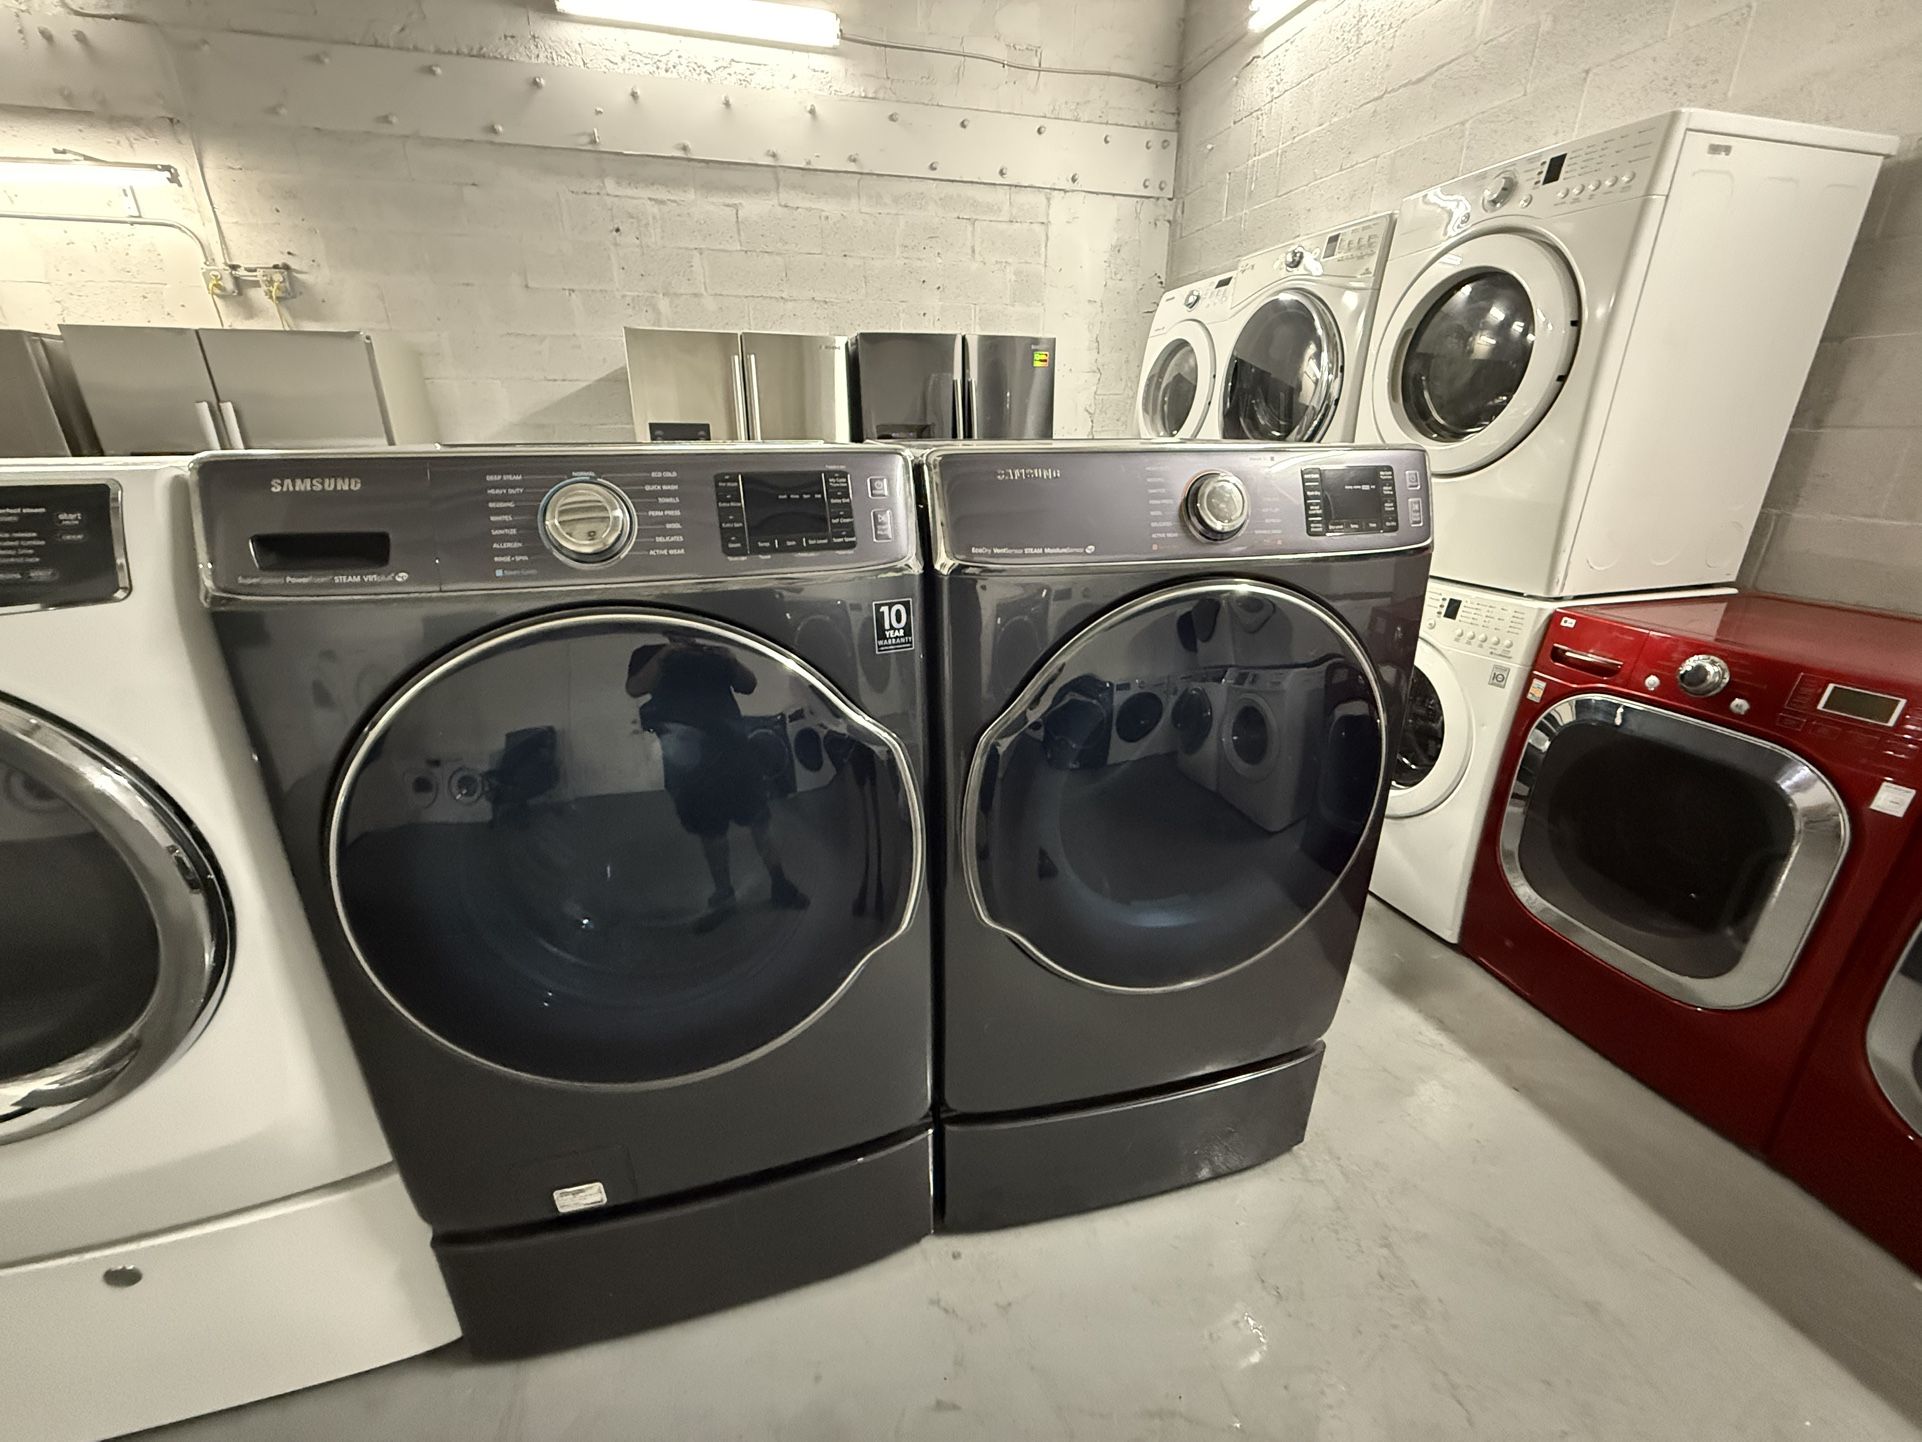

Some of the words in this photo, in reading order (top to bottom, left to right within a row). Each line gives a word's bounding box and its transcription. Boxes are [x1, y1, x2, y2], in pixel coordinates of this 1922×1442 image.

[270, 477, 362, 492] SAMSUNG
[334, 575, 361, 583] STEAM
[879, 603, 907, 630] 10
[885, 629, 905, 638] YEAR
[877, 637, 912, 646] WARRANTY
